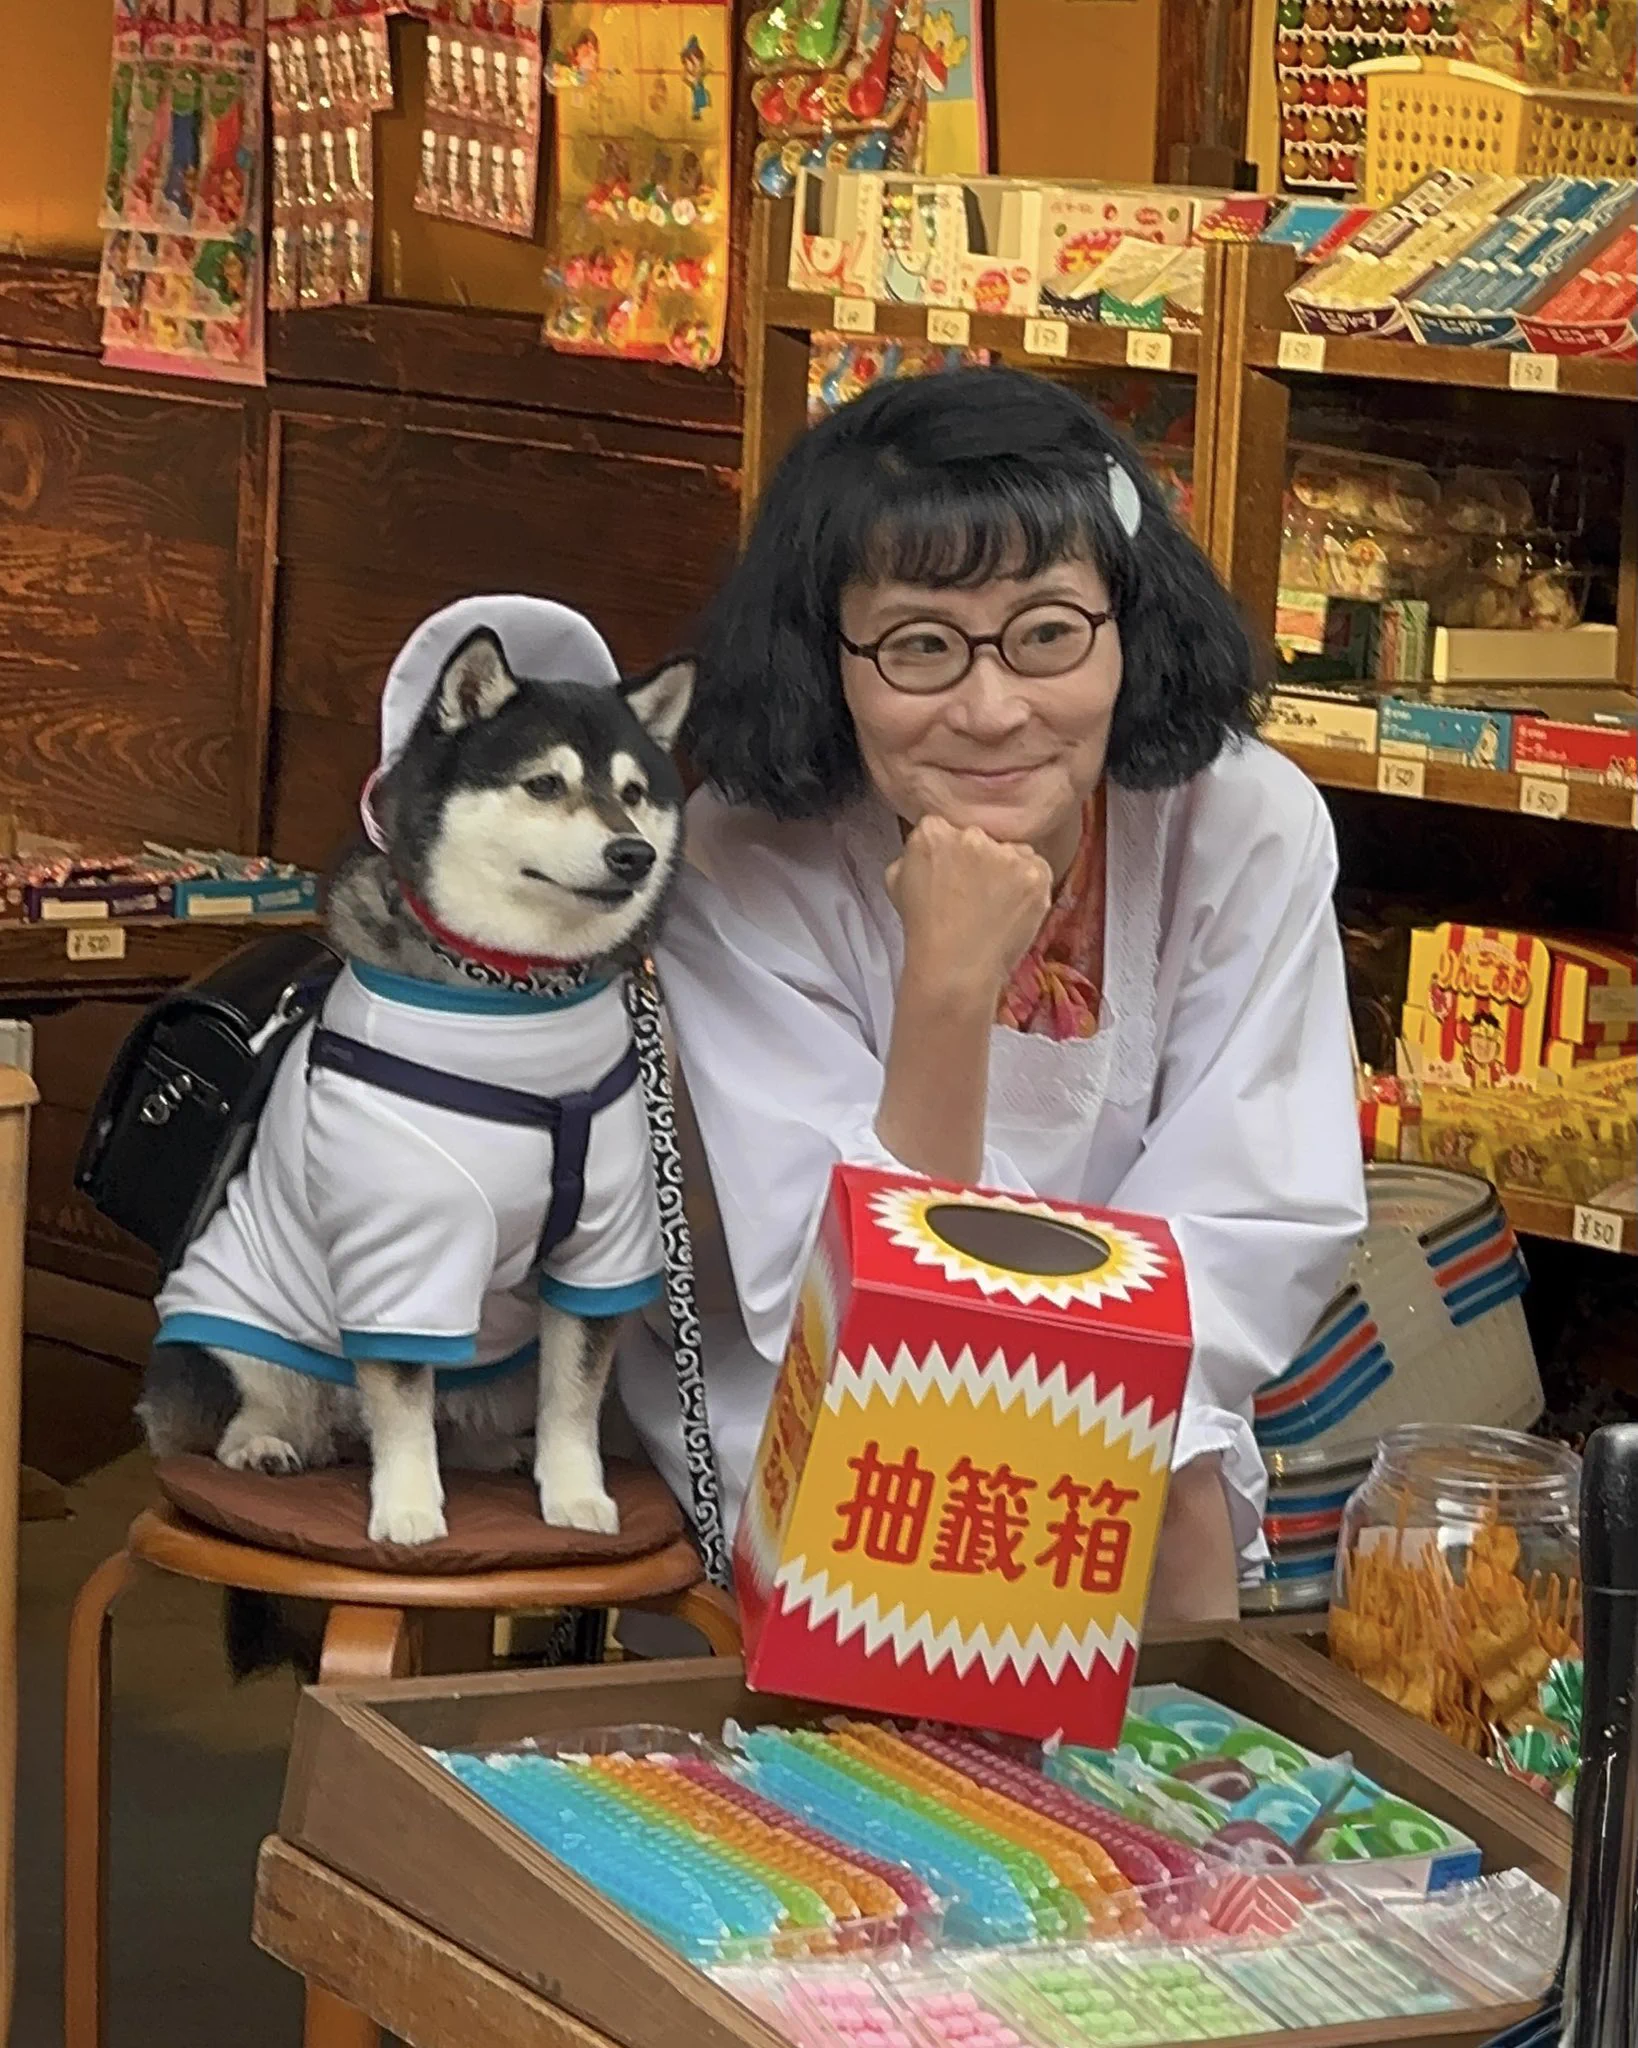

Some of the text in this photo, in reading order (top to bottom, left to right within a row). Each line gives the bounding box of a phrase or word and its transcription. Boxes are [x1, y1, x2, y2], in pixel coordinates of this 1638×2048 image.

[1580, 1211, 1615, 1245] ¥50
[832, 1440, 1140, 1594] 抽籤箱
